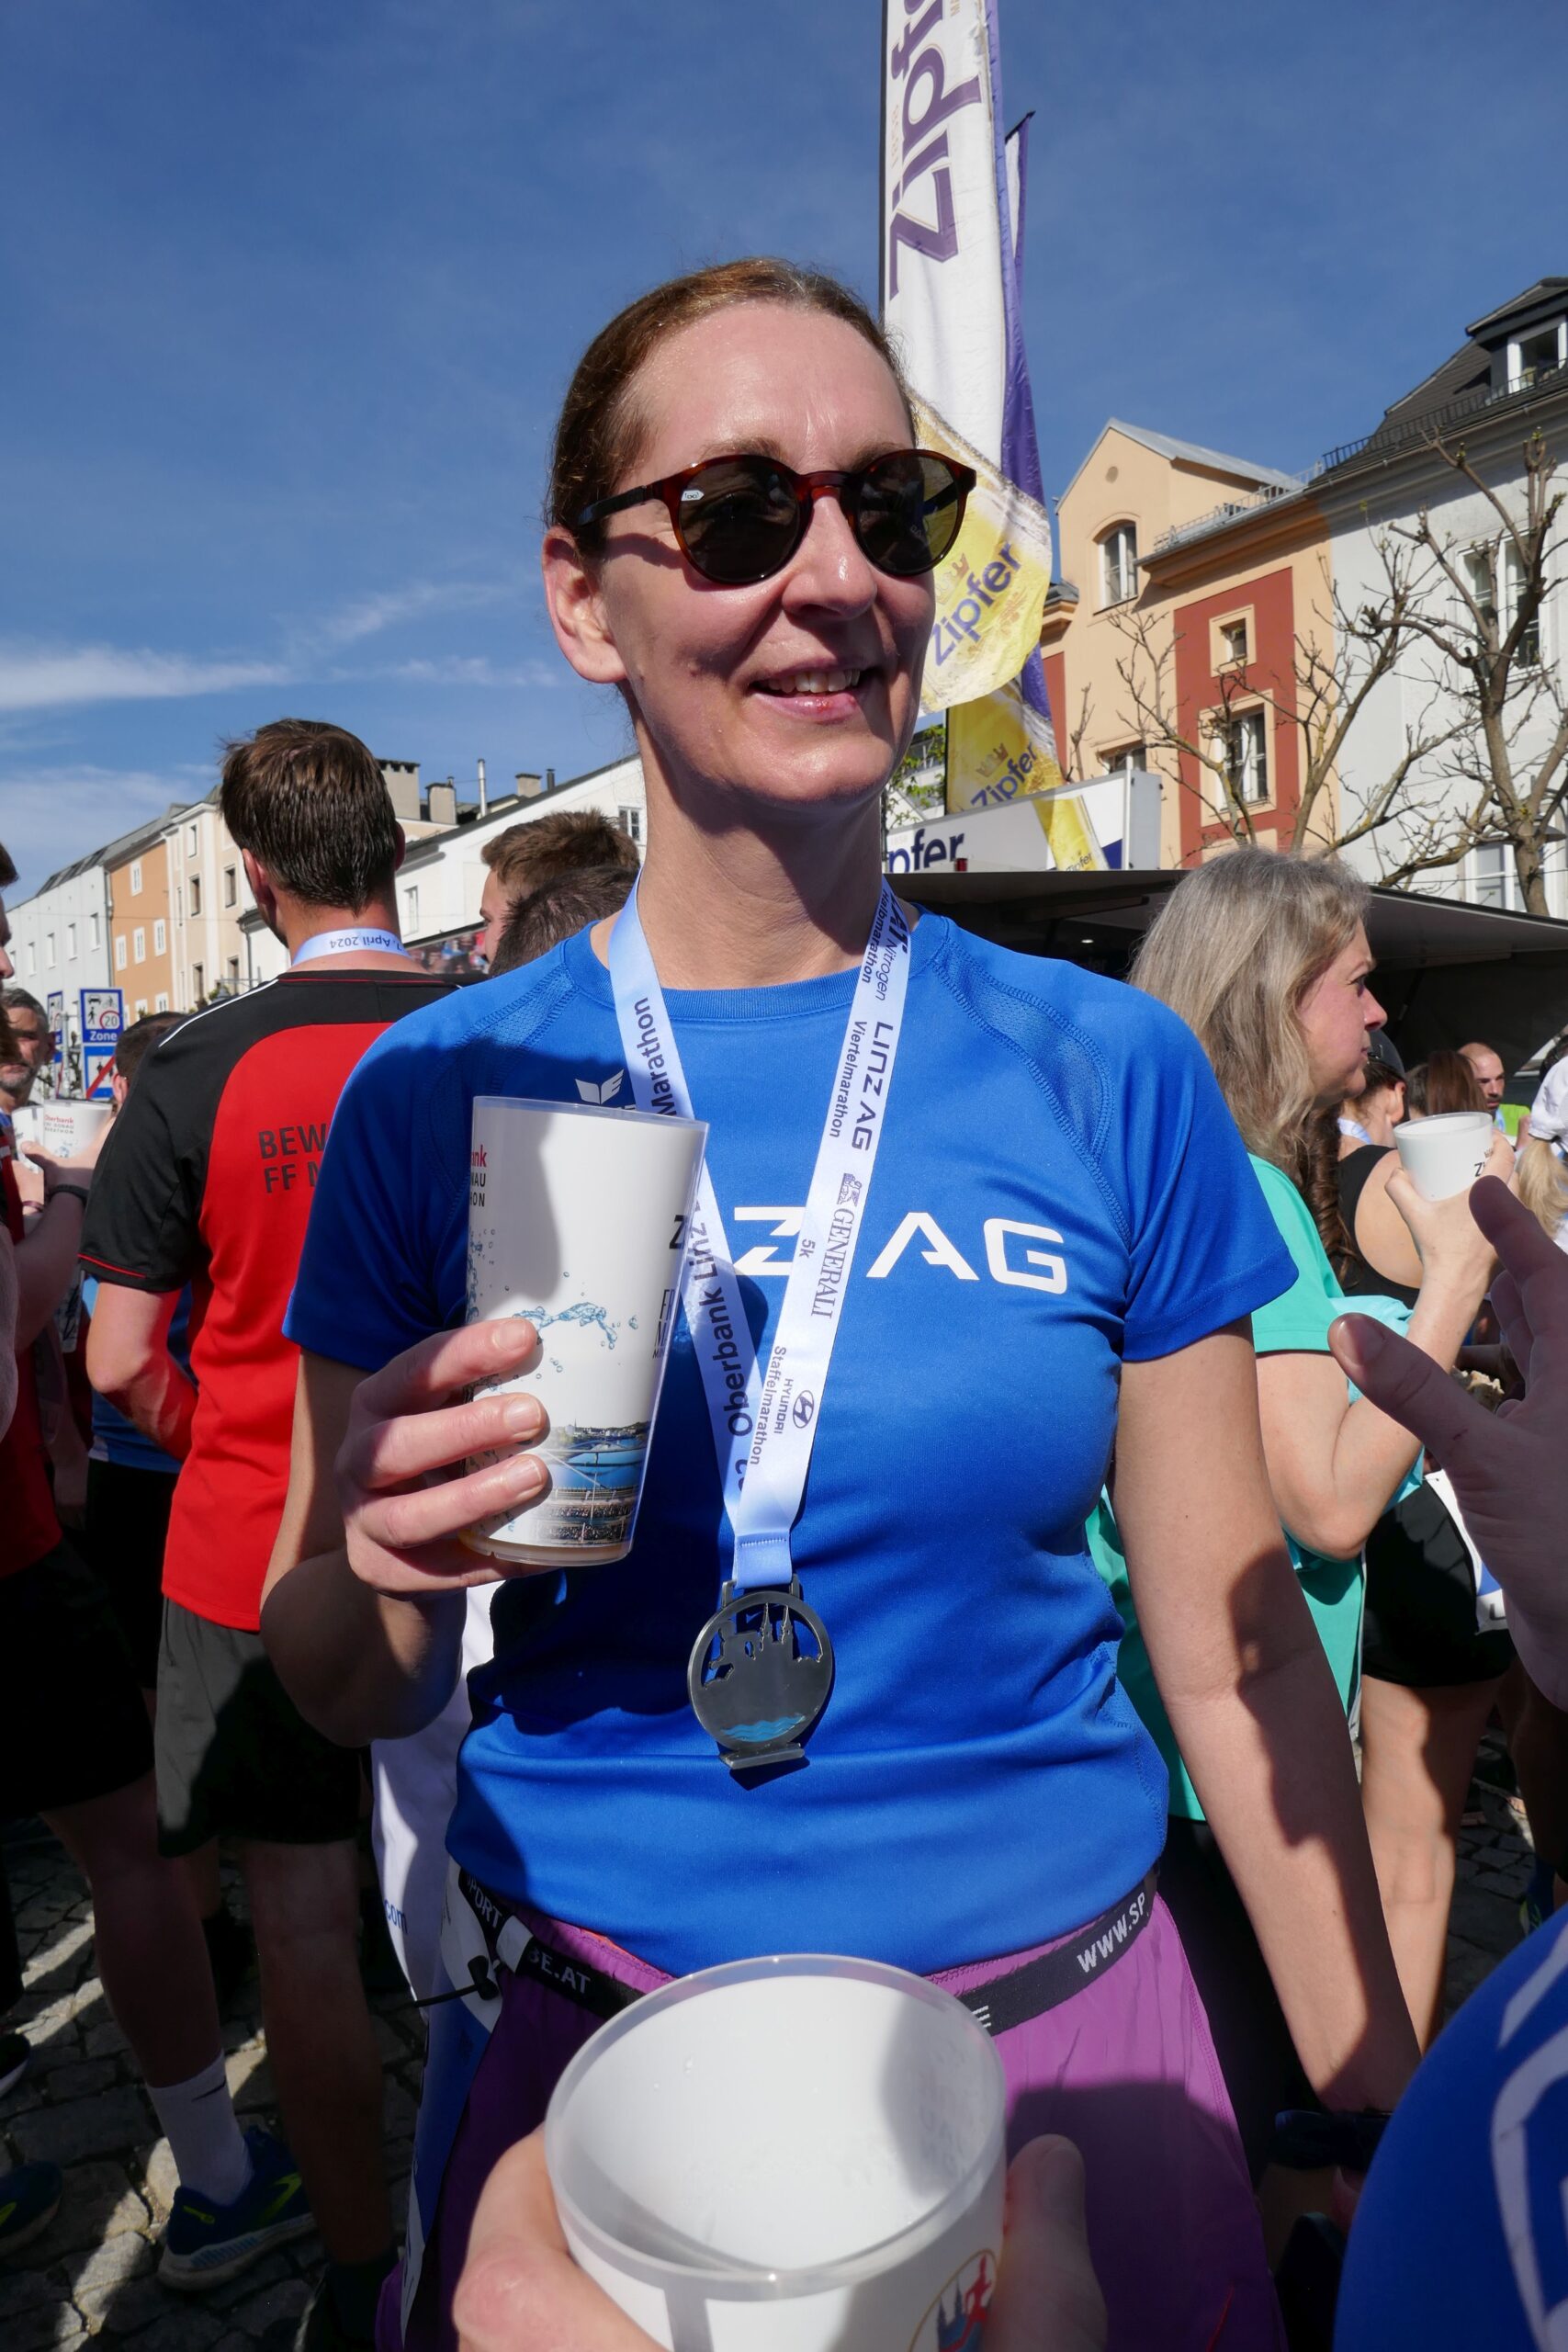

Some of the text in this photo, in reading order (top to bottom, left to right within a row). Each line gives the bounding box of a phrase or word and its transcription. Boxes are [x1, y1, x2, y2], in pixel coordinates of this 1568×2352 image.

[930, 542, 1022, 667] Zipfer
[330, 935, 359, 949] 2024
[362, 934, 391, 948] April
[874, 938, 898, 1001] Nitrogen
[90, 1030, 118, 1042] Zone
[104, 1014, 118, 1027] 20
[829, 1021, 867, 1138] Viertelmarathon
[851, 1100, 877, 1151] AG
[265, 1163, 297, 1193] FF
[689, 1222, 719, 1282] Linz
[798, 1238, 817, 1259] 5k
[811, 1207, 855, 1319] GENERALI
[865, 1211, 1068, 1295] AG
[698, 1286, 753, 1437] Oberbank
[750, 1345, 787, 1465] Staffelmarathon
